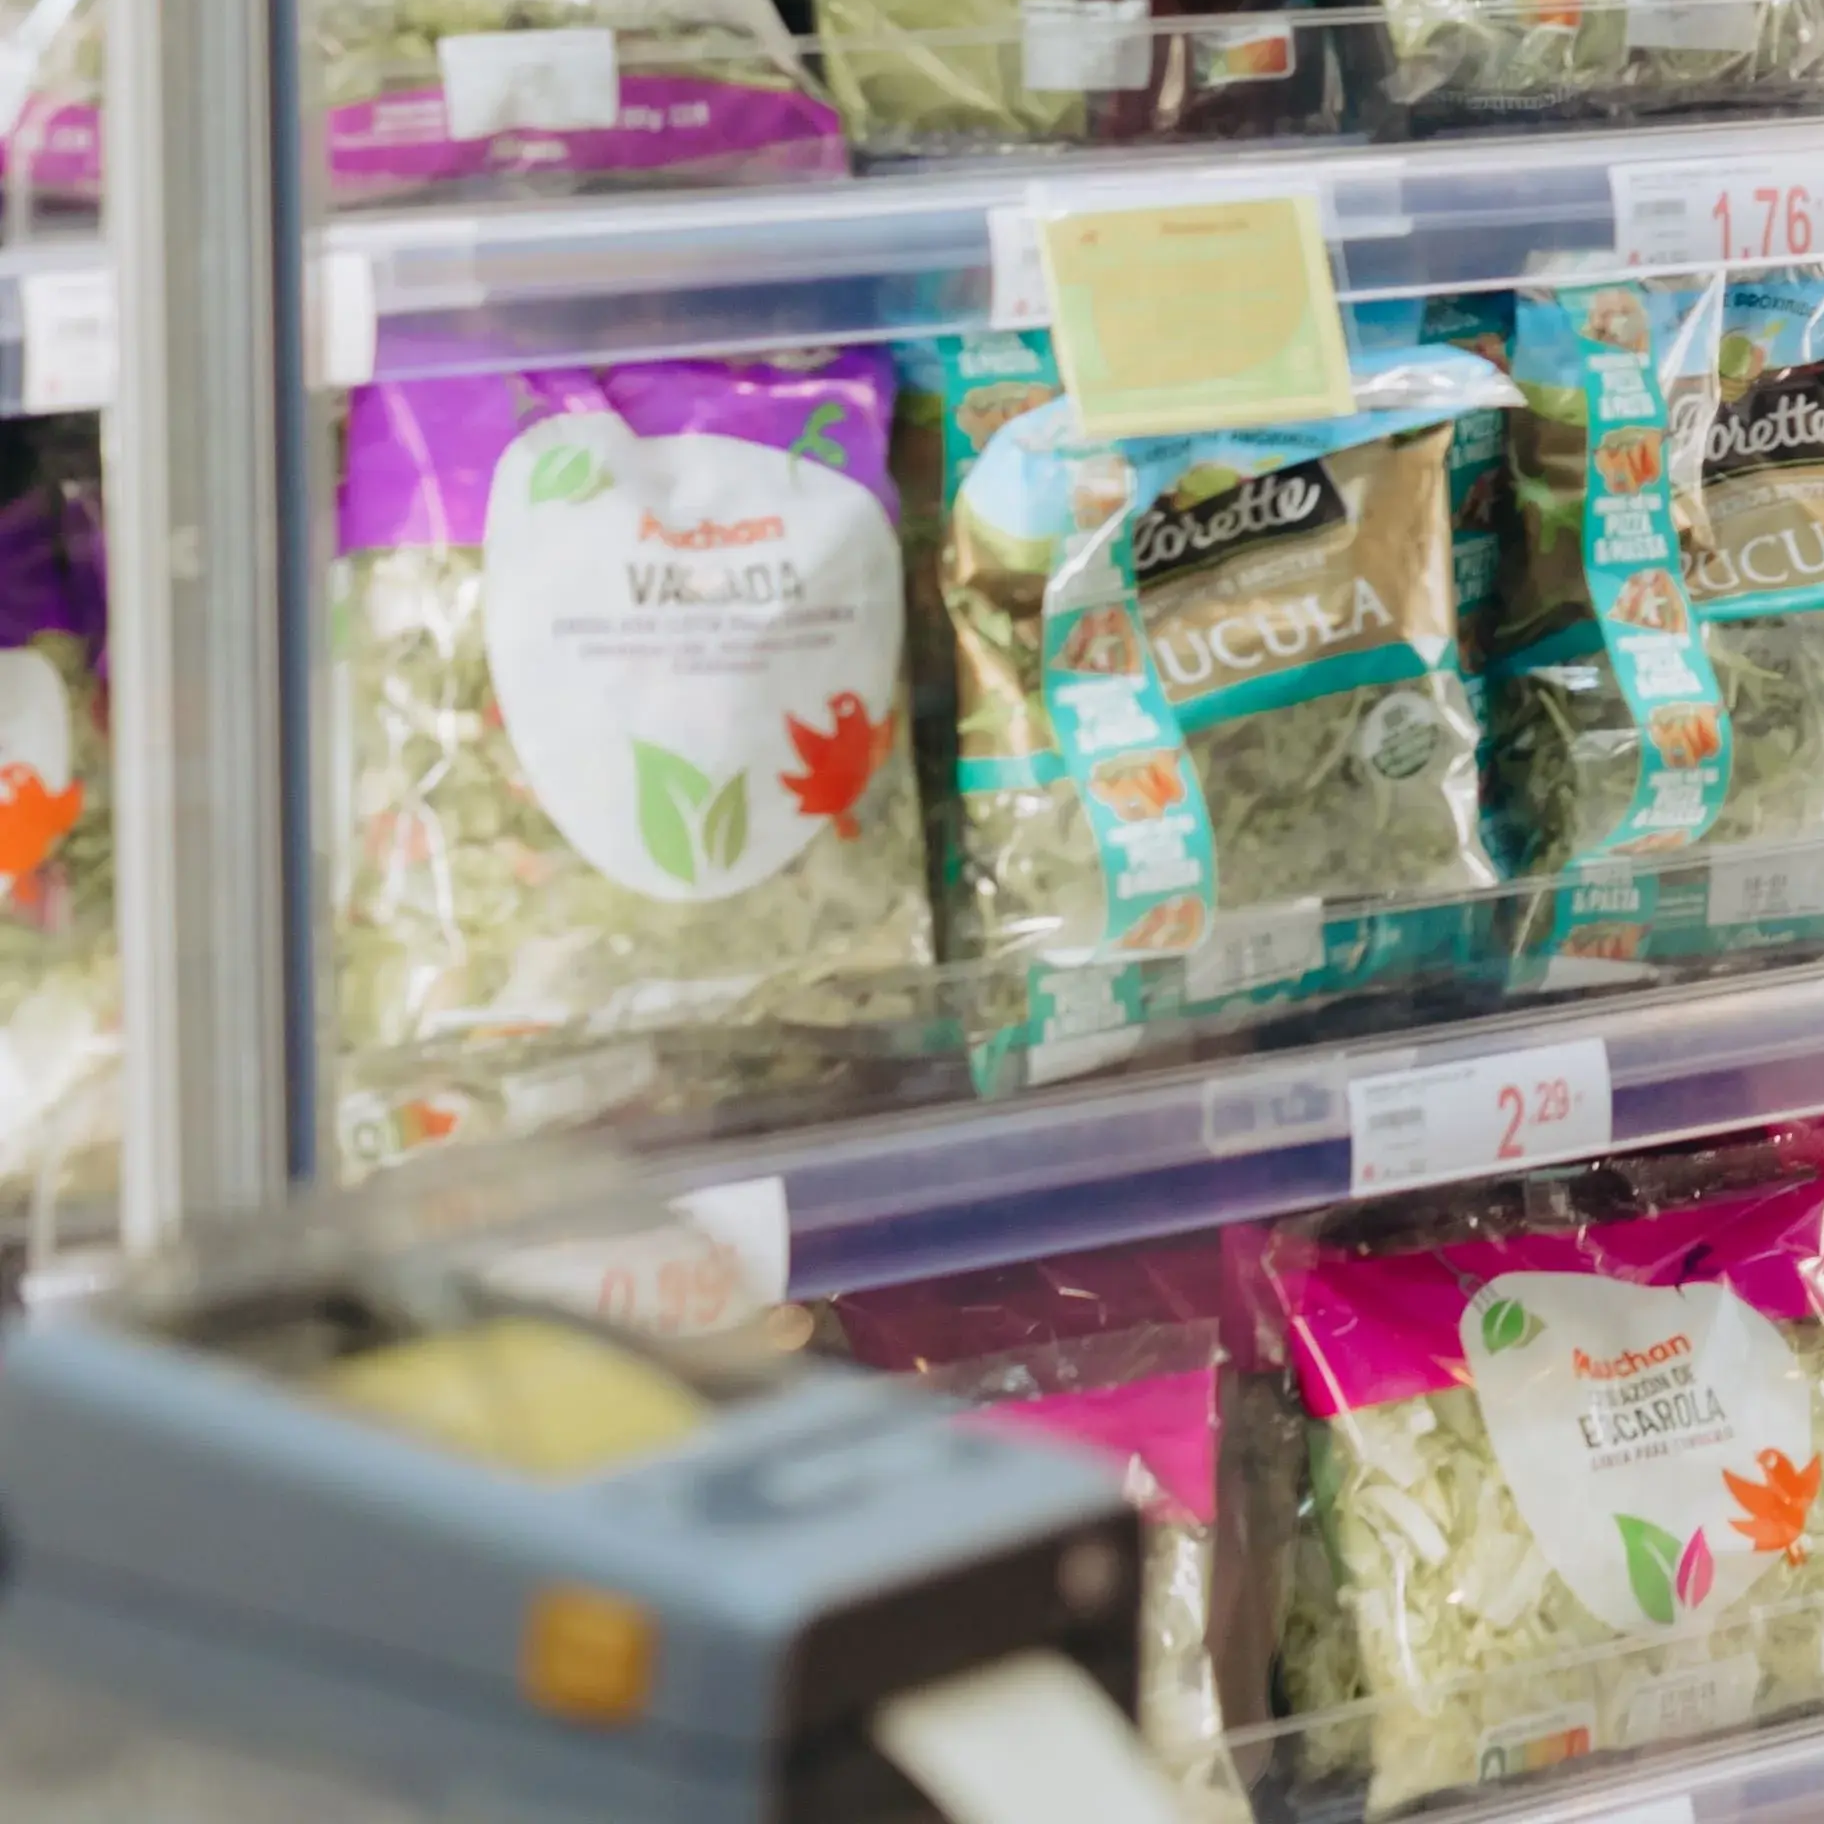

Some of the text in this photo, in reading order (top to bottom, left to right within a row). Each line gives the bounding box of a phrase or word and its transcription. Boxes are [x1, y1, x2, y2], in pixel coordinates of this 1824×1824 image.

[1712, 186, 1813, 260] 1.76
[1133, 475, 1322, 569] lorette
[1496, 1081, 1570, 1160] 2.29
[1572, 1333, 1692, 1381] Auchan
[1578, 1386, 1727, 1449] ECAROLA
